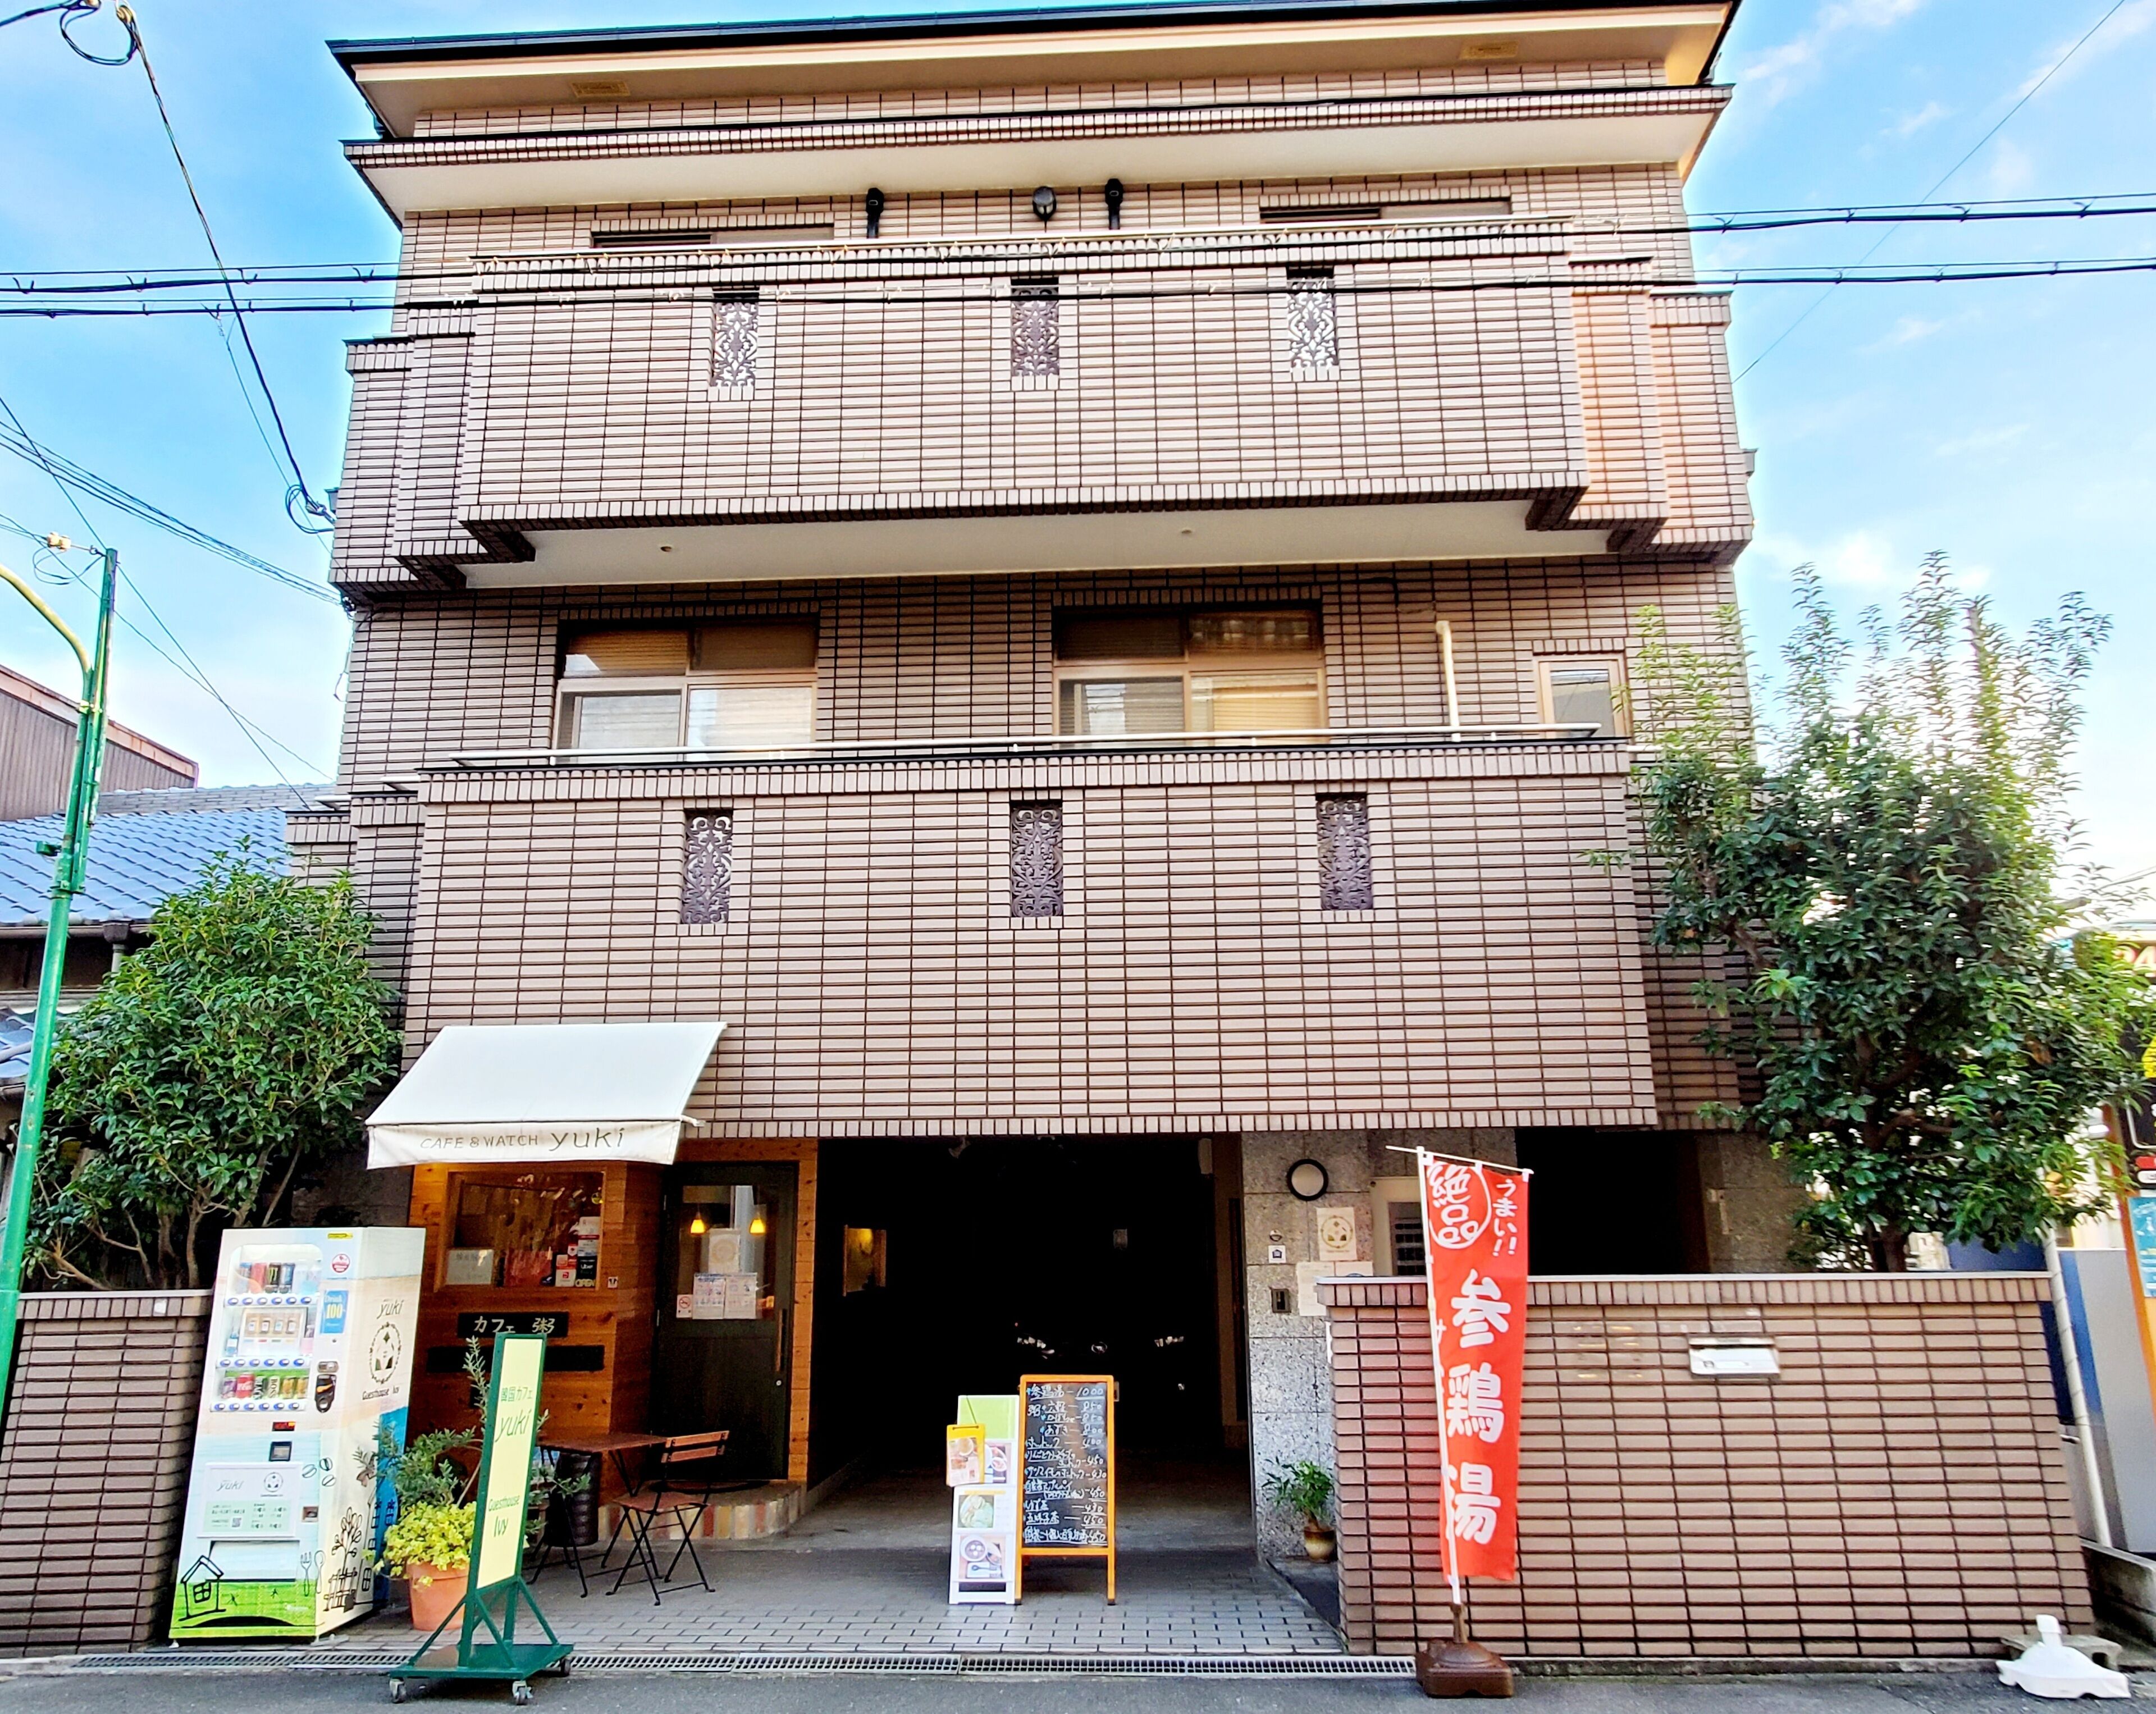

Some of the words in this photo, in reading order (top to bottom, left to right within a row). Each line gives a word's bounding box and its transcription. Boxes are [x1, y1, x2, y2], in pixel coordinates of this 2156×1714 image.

[420, 1137, 464, 1150] CAFE
[483, 1135, 538, 1147] WATCH
[549, 1127, 625, 1151] yuki
[1429, 1164, 1480, 1245] 絶品
[377, 1300, 404, 1319] yuki
[474, 1315, 516, 1334] カフェ
[532, 1317, 556, 1334] 粥
[1446, 1268, 1512, 1546] 参鶏湯
[495, 1409, 532, 1443] yuki
